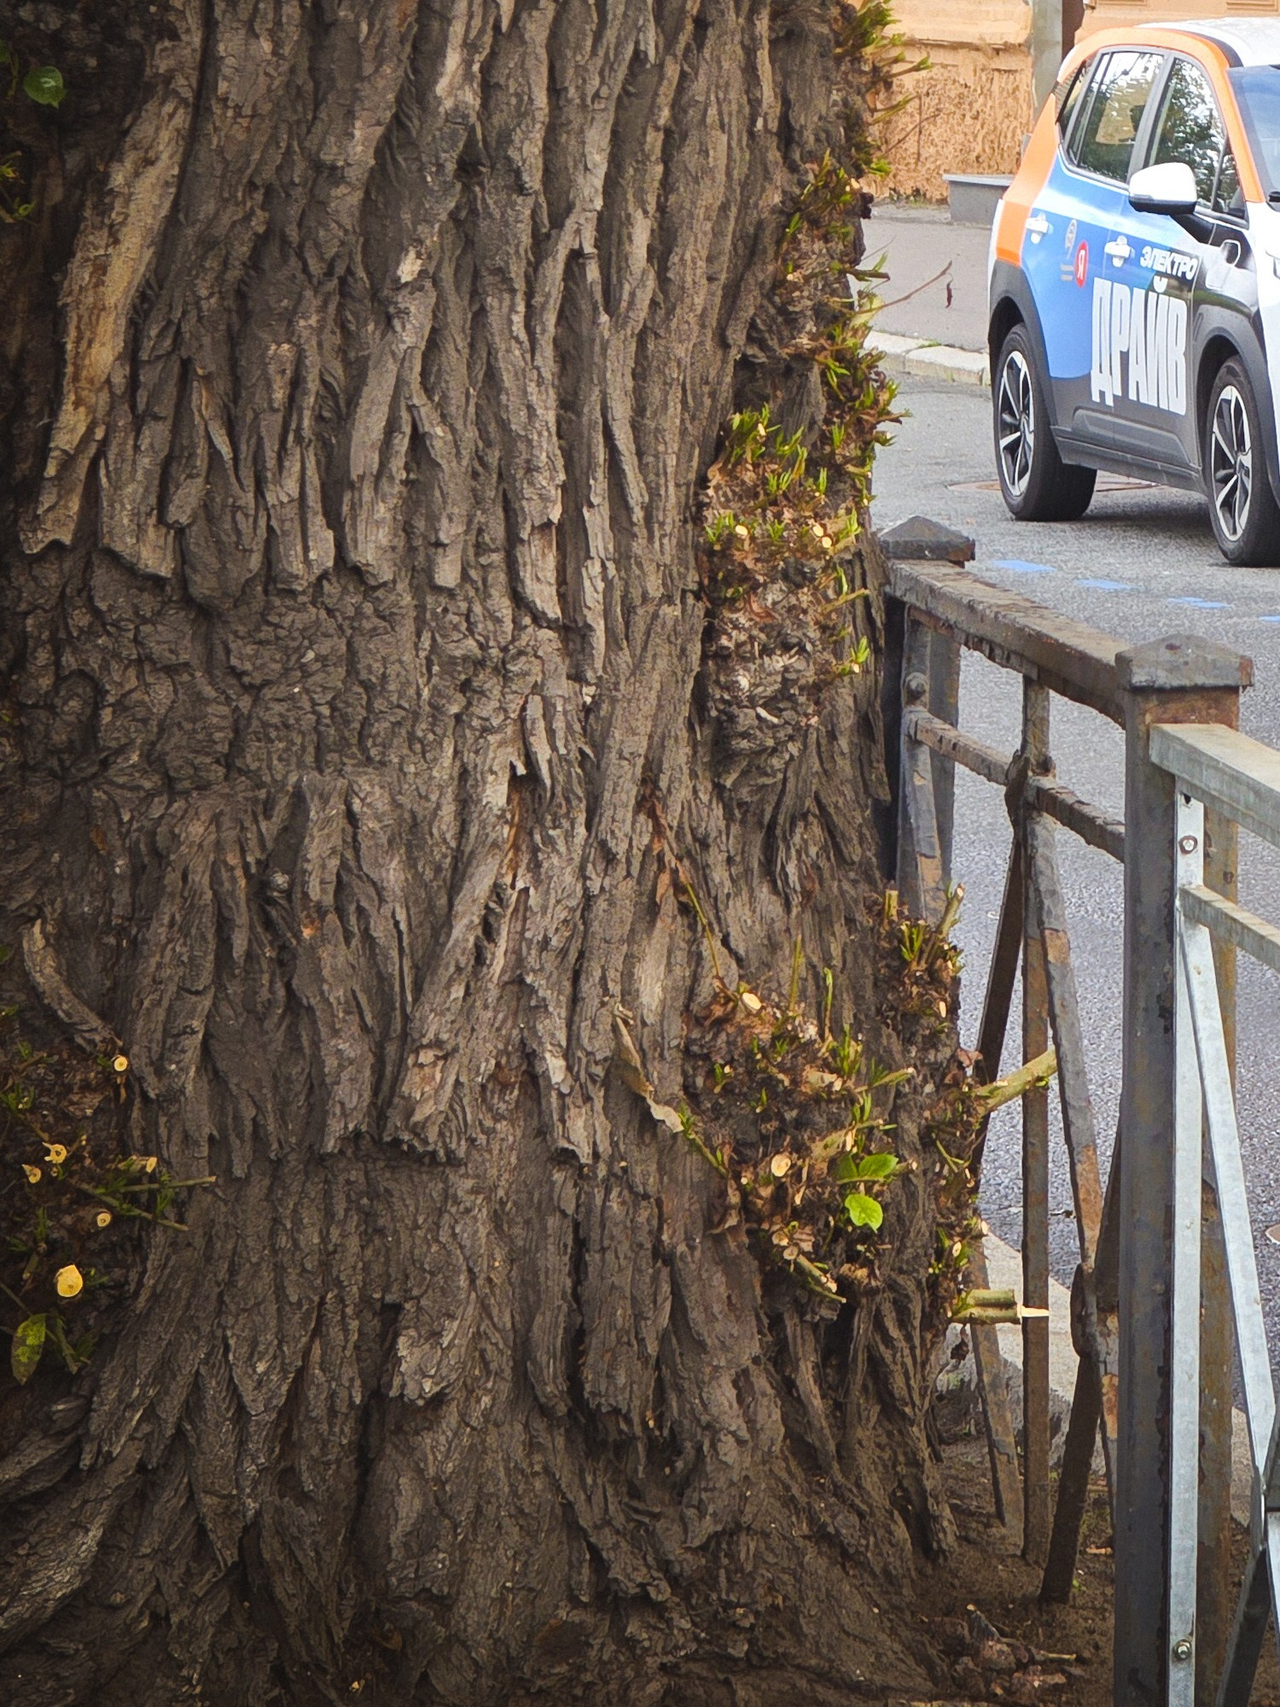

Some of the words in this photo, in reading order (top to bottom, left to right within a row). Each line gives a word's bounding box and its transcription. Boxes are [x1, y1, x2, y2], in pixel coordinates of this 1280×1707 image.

[1077, 249, 1086, 280] Я
[1140, 246, 1198, 280] ЭЛЕКТРО
[1091, 276, 1188, 416] ДРАЙВ
